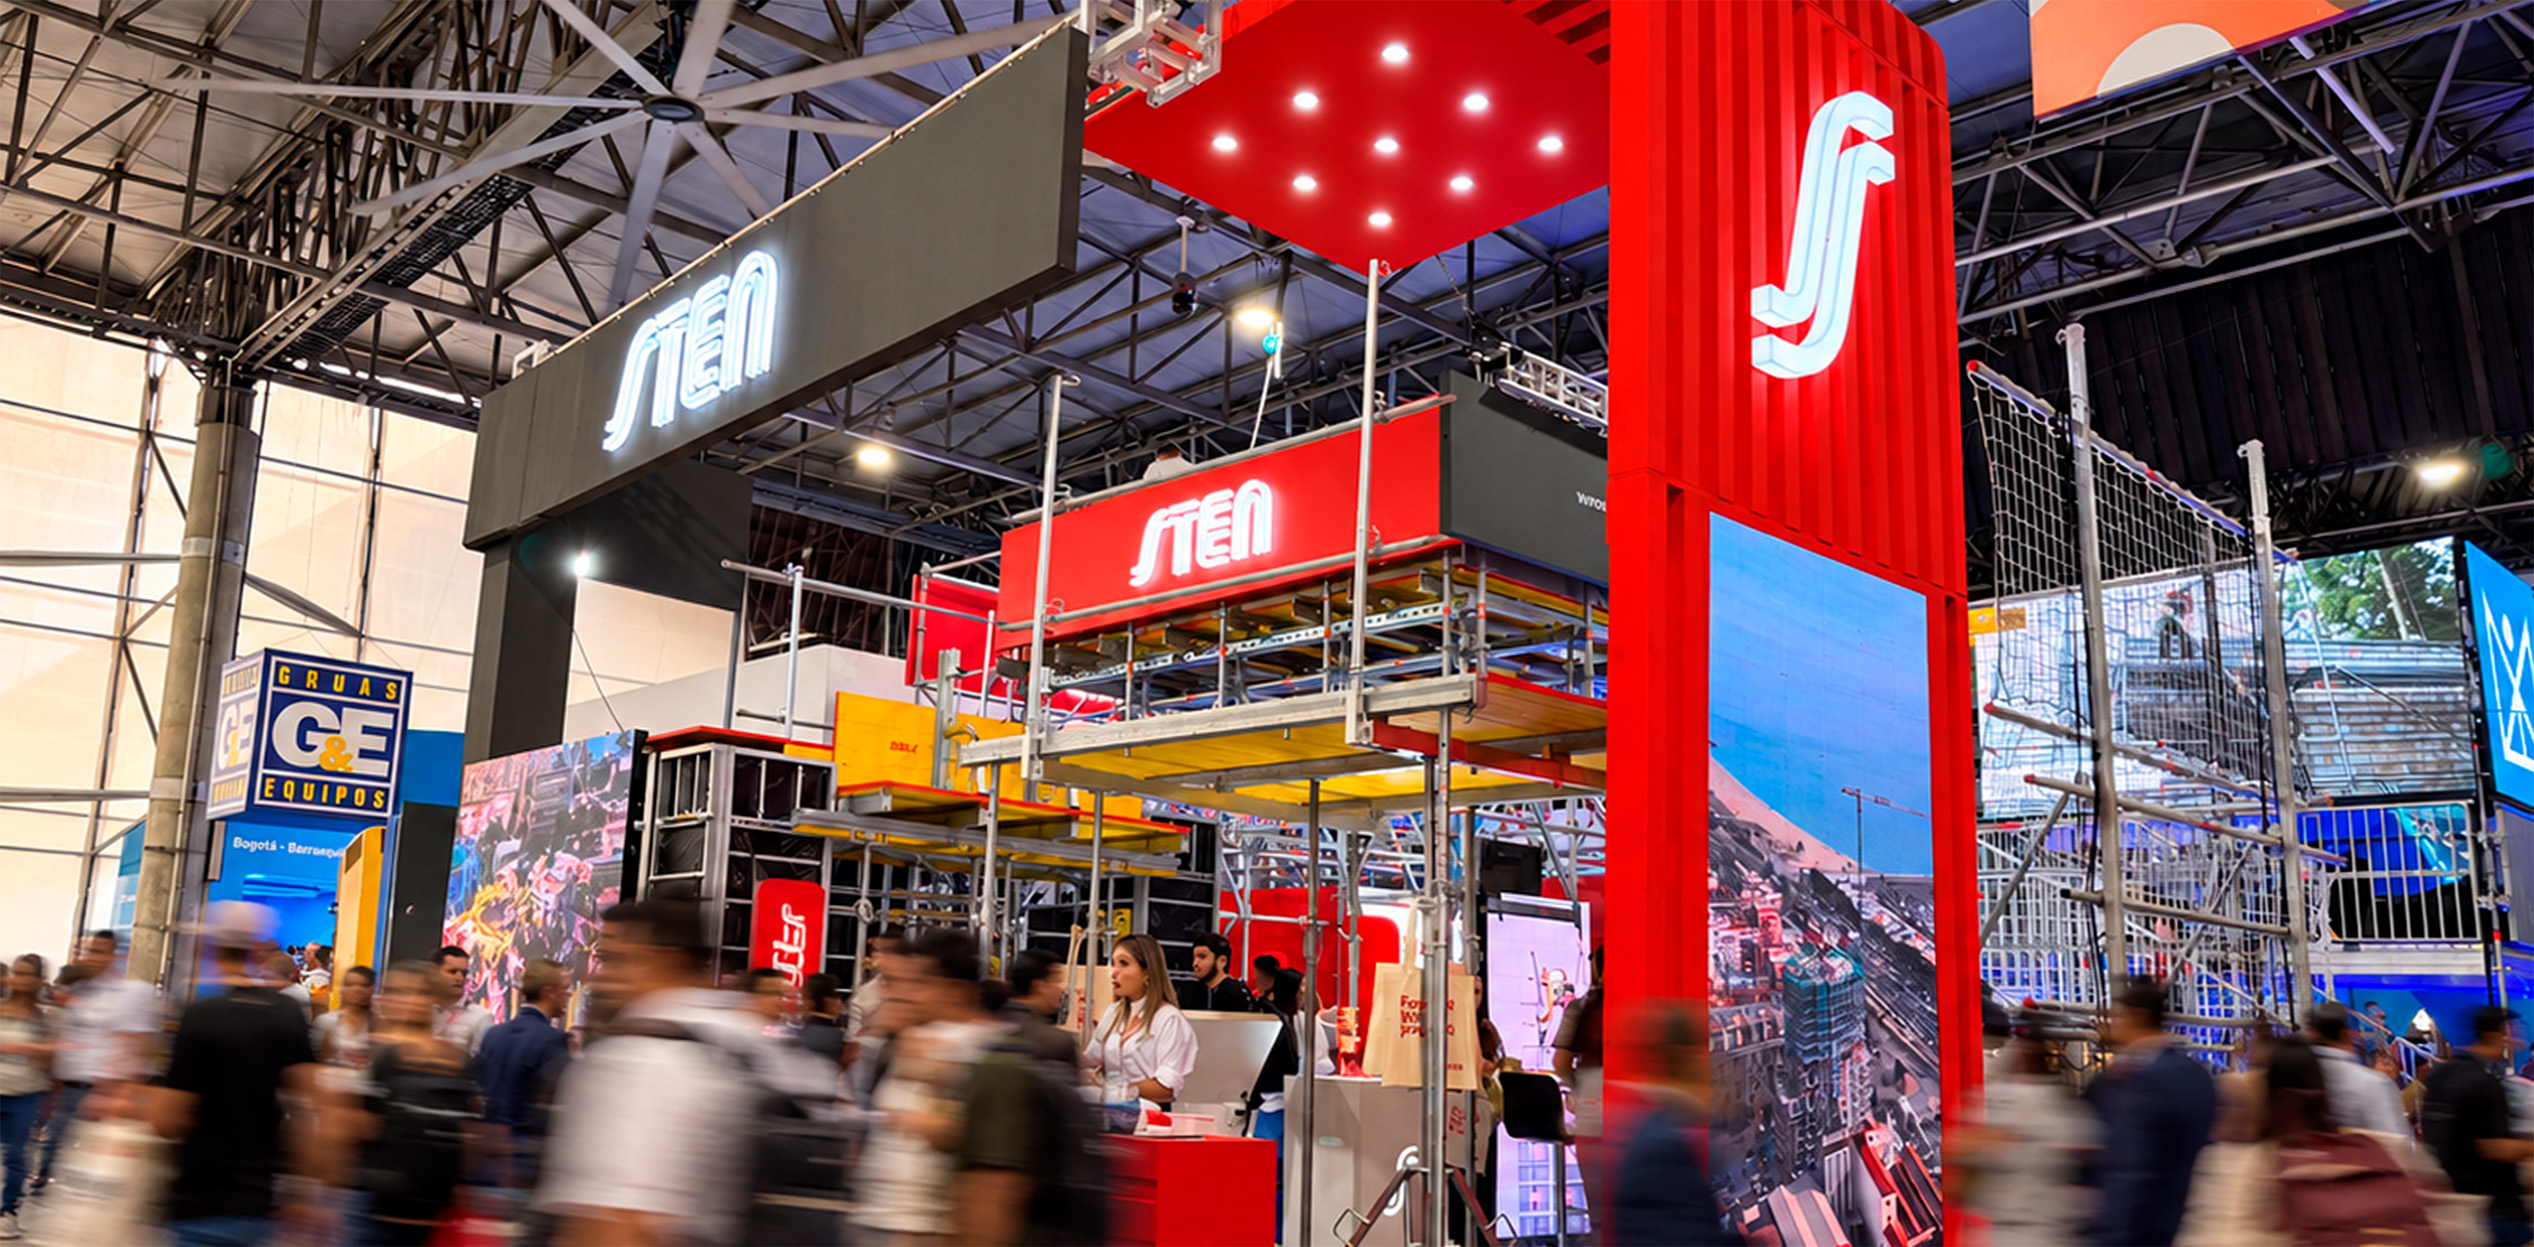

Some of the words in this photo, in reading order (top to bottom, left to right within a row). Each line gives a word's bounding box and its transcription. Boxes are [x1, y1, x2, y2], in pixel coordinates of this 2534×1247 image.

[602, 250, 779, 452] STEN
[1129, 478, 1273, 587] STEN
[278, 665, 398, 700] GRUAS
[272, 701, 394, 777] G&E
[264, 777, 386, 809] EQUIPOS
